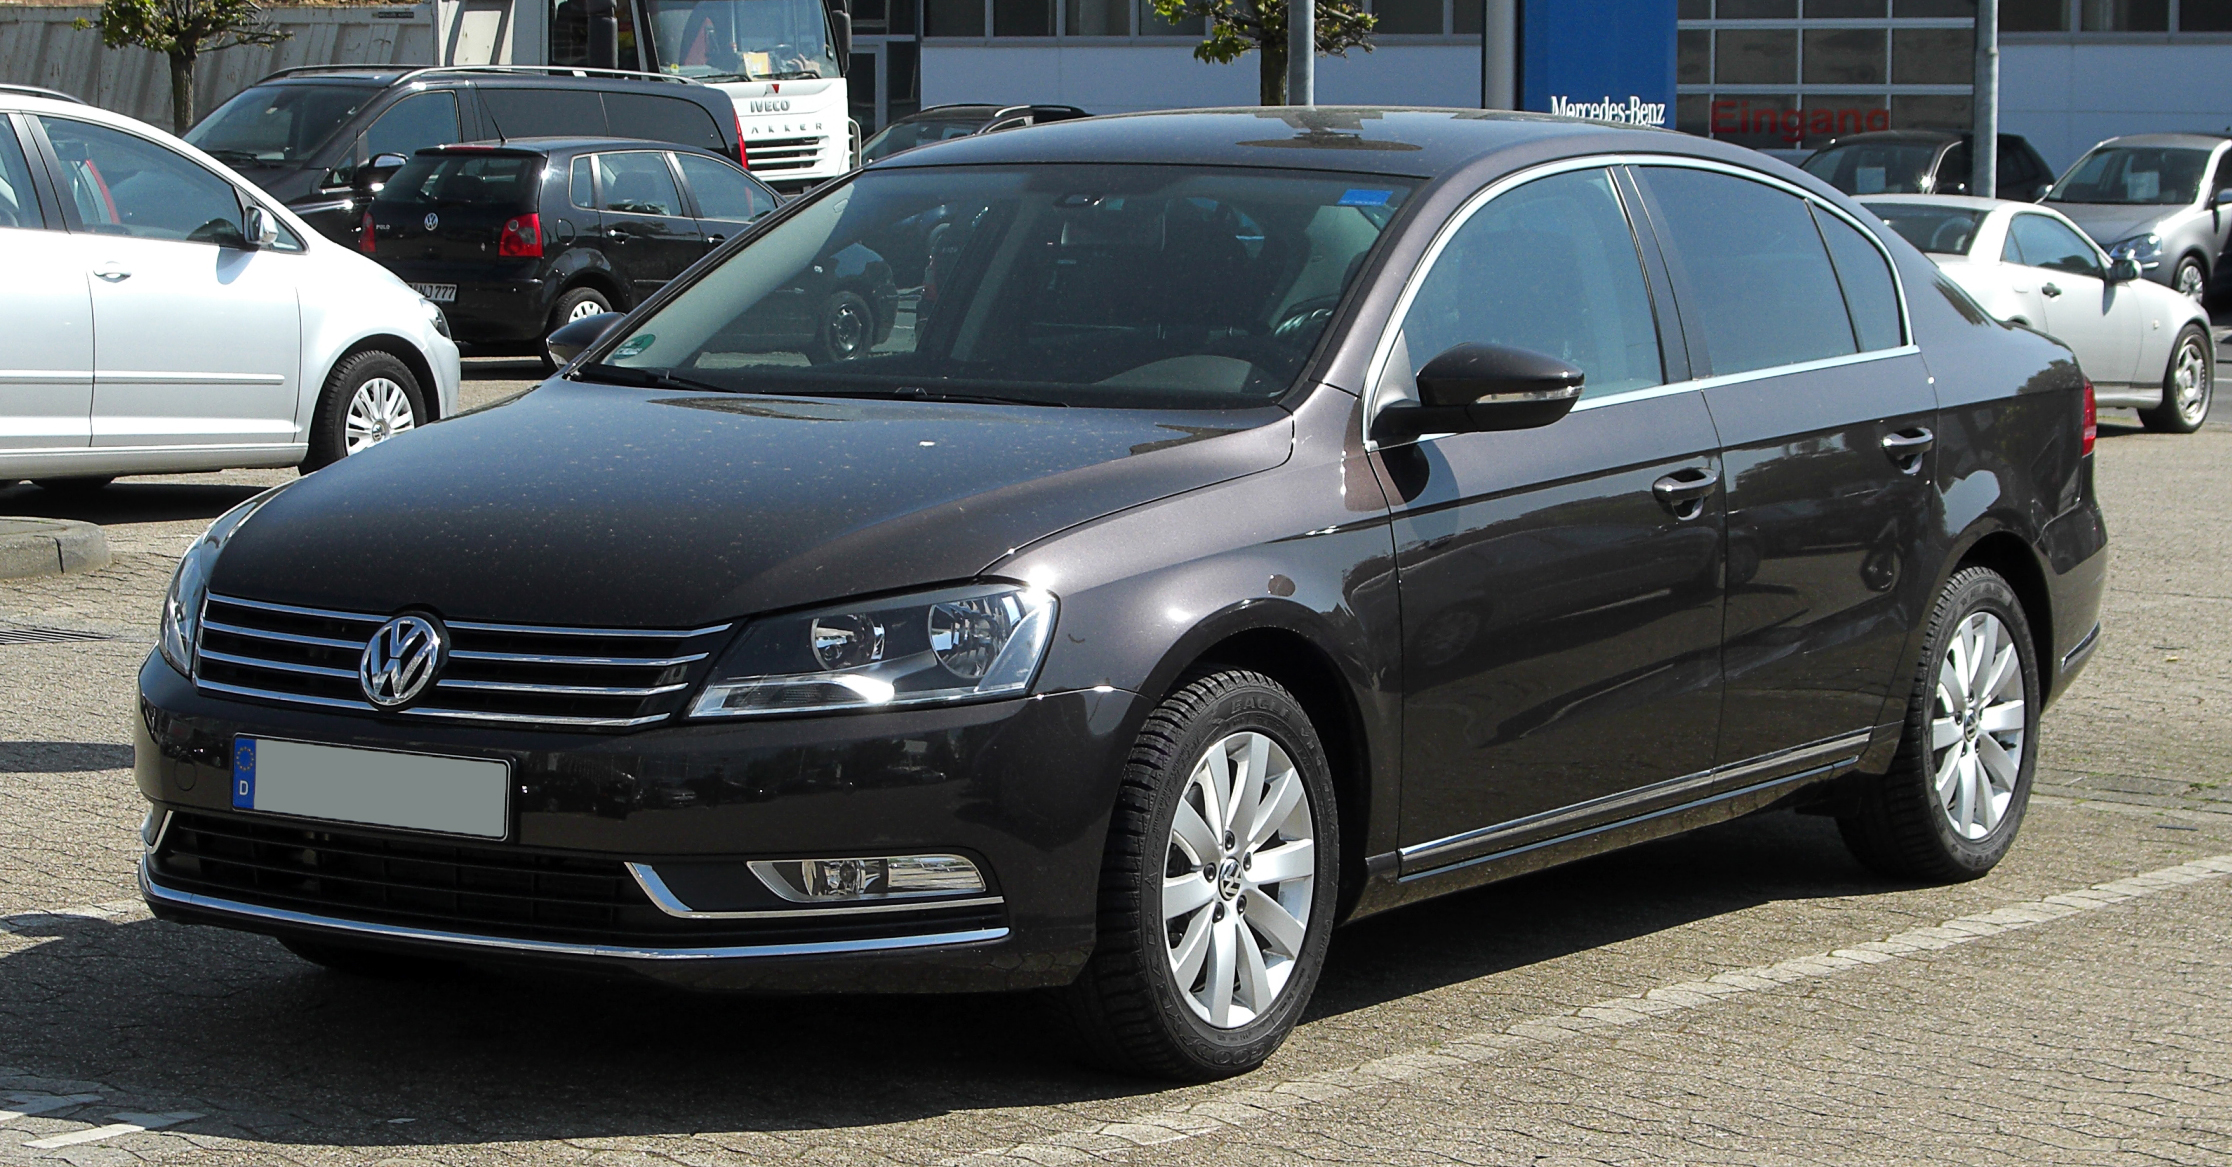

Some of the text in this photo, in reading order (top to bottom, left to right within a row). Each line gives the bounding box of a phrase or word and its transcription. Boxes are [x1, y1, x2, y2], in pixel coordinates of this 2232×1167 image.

[750, 100, 790, 113] IVECO
[1551, 96, 1666, 125] Mercedes-Benz
[1711, 101, 1890, 143] Eingang
[1231, 697, 1293, 722] EAGLE
[239, 780, 249, 796] D
